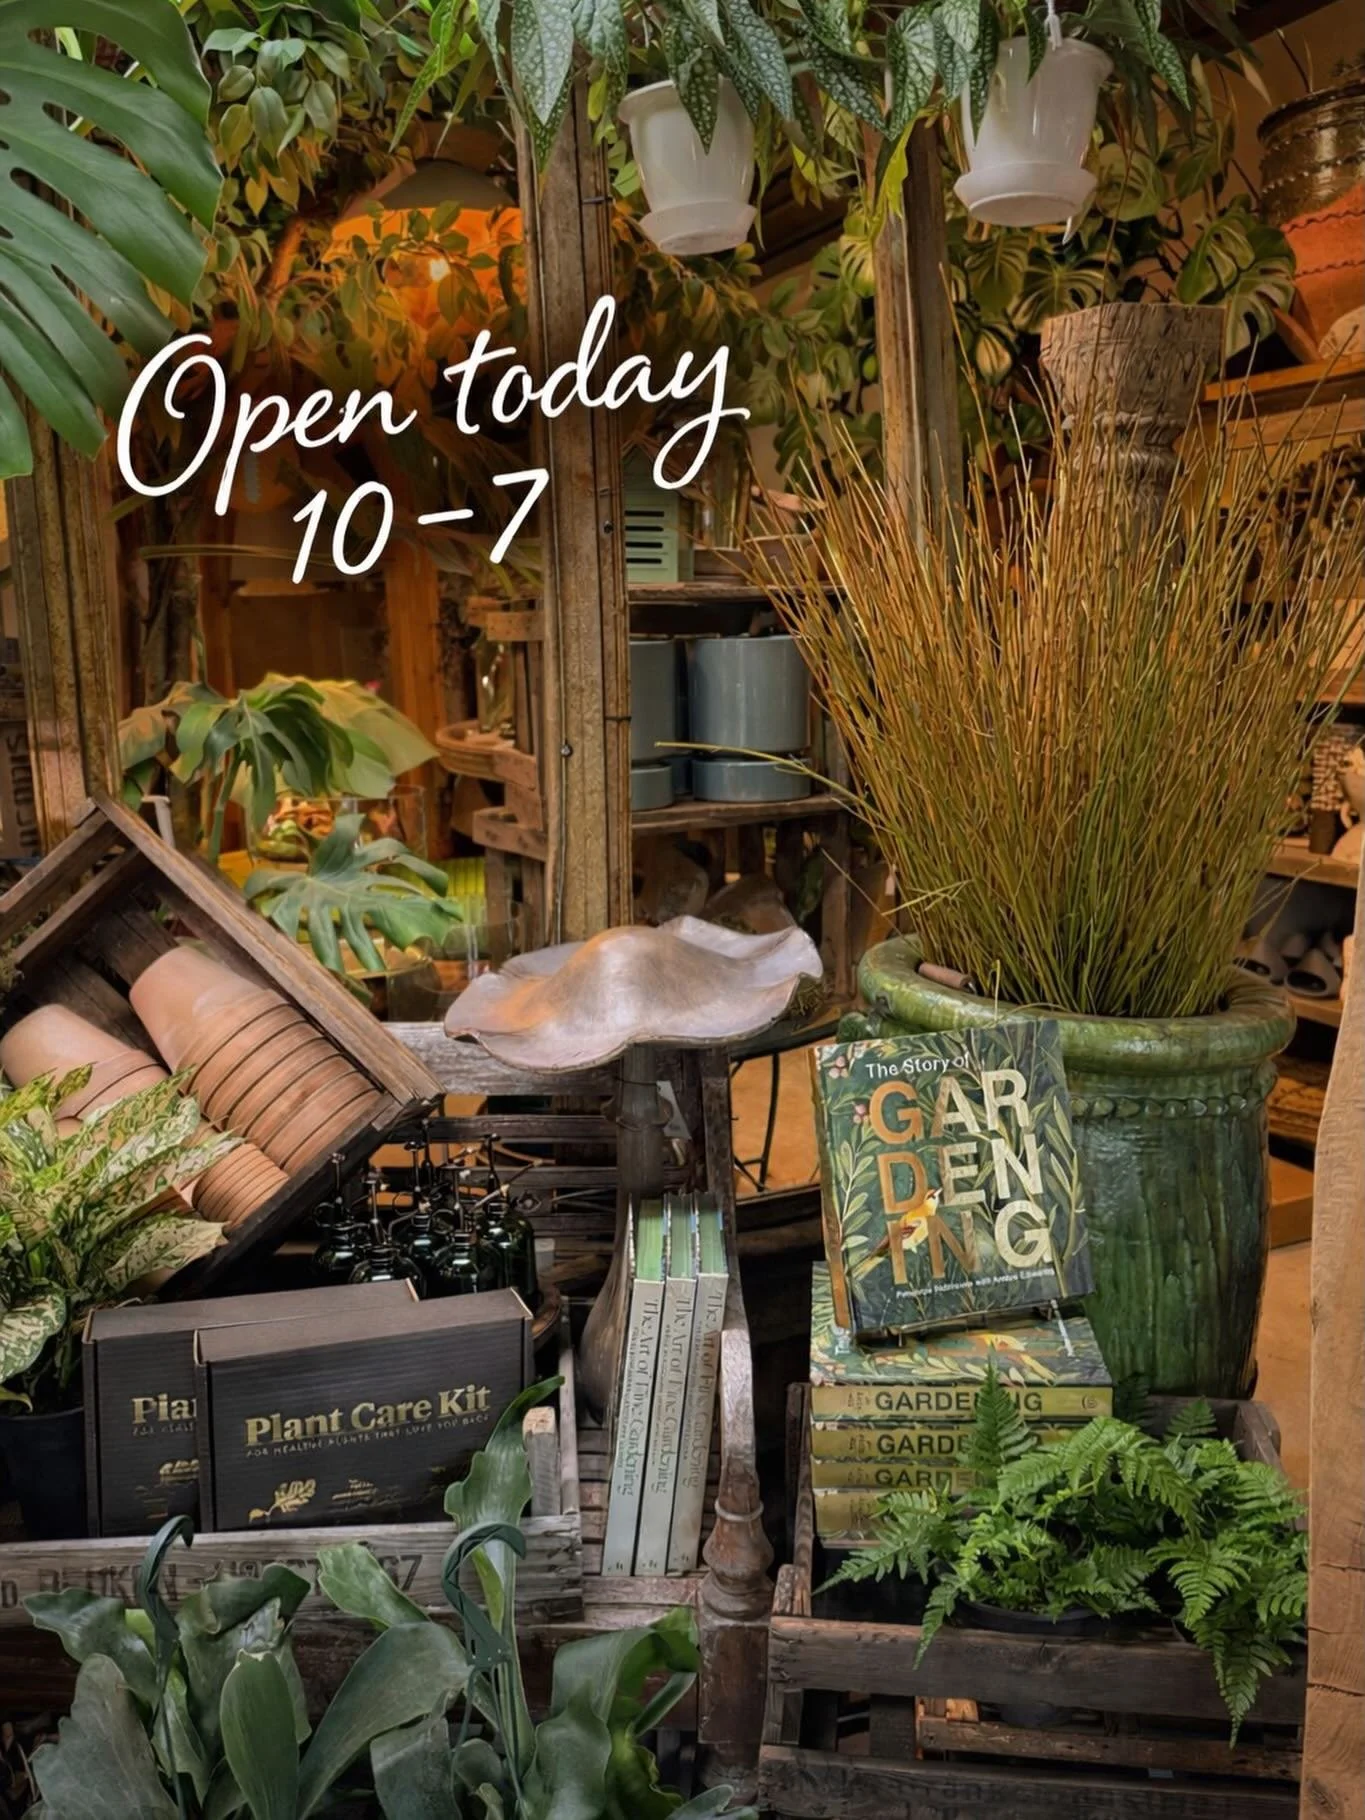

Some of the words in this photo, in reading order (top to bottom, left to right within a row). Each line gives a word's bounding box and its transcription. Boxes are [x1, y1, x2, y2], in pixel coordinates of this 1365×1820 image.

[865, 1061, 900, 1079] The
[901, 1055, 950, 1074] Story
[951, 1053, 970, 1069] of
[869, 1068, 1030, 1145] GAR
[877, 1133, 1044, 1215] DEN
[887, 1199, 1054, 1285] ING
[245, 1407, 344, 1447] Plant
[351, 1400, 433, 1432] Care
[435, 1384, 492, 1419] Kit
[875, 1391, 1042, 1411] GARDEG
